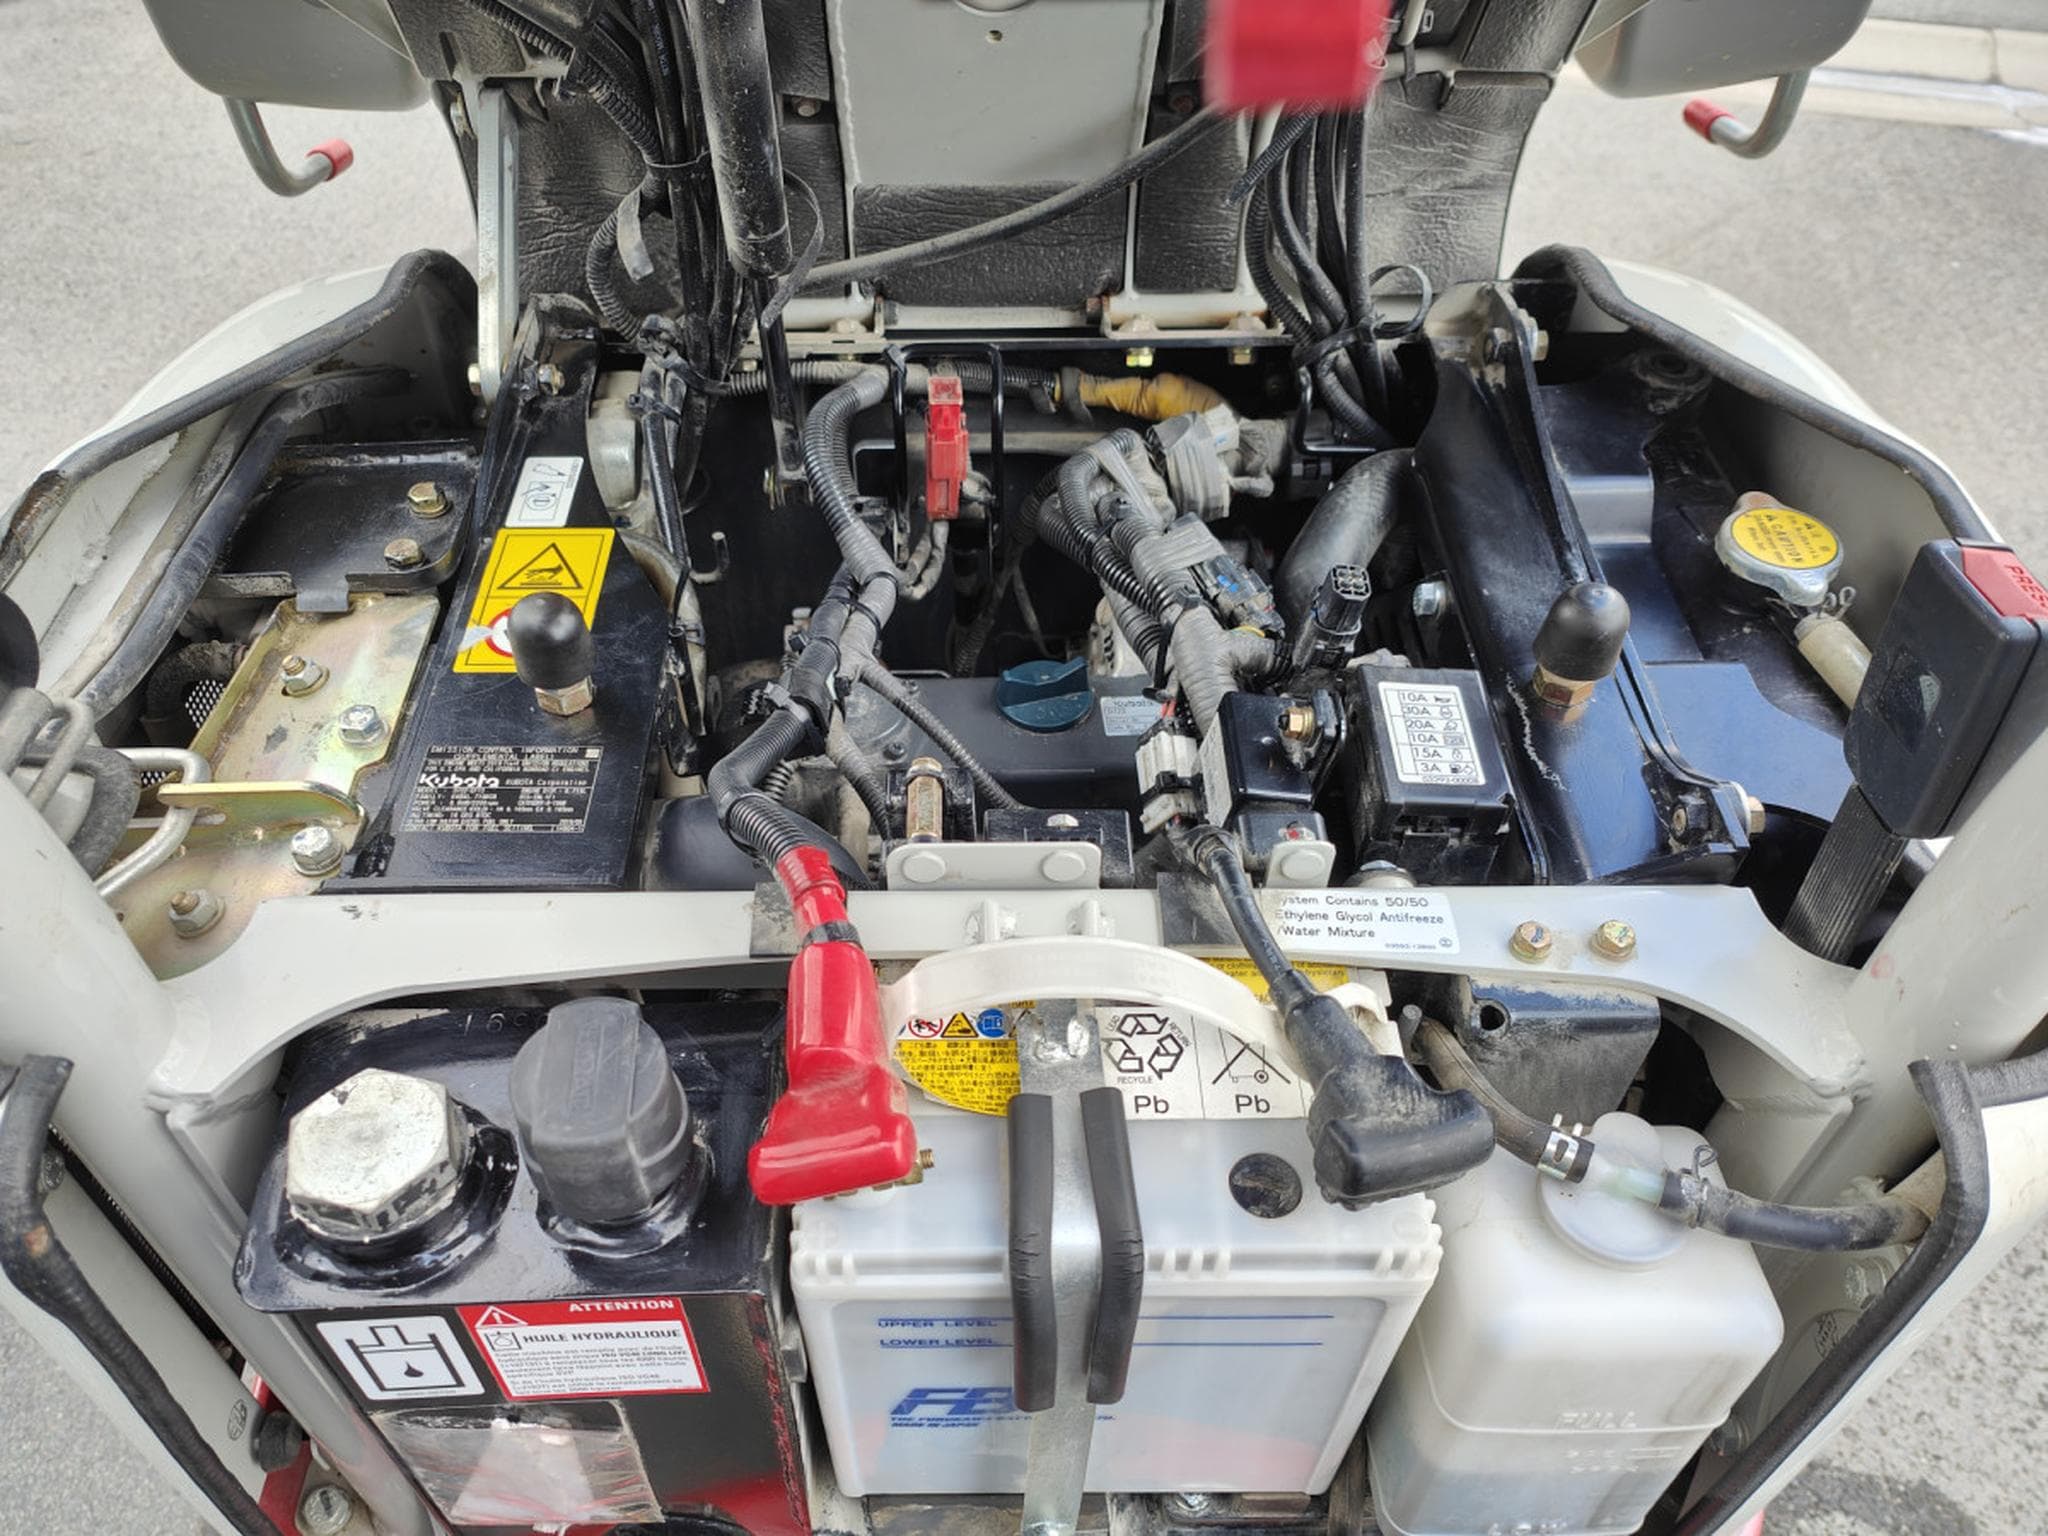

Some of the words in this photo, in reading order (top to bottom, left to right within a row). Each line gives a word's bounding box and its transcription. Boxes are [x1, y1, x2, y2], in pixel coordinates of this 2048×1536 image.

[2004, 563, 2048, 609] PRES
[1401, 692, 1428, 702] 10A
[1407, 719, 1435, 730] 20A
[1411, 733, 1439, 744] 10A
[1414, 747, 1443, 759] 15A
[1421, 762, 1442, 773] 3A
[419, 773, 500, 788] Kubota
[1281, 895, 1319, 907] ystem
[1325, 895, 1379, 907] Contains
[1385, 896, 1429, 908] 50/50
[1275, 910, 1329, 922] Ethylene
[1335, 911, 1373, 923] Glycol
[1379, 912, 1444, 925] Antifreeze
[1327, 925, 1375, 939] Mixture
[1117, 1076, 1154, 1085] RECYCLE
[1134, 1095, 1170, 1114] Pb
[1235, 1094, 1271, 1114] Pb
[569, 1300, 674, 1313] ATTENTION
[878, 1319, 934, 1328] UPPER
[944, 1319, 998, 1328] LEVEL
[523, 1331, 569, 1344] HUILE
[572, 1329, 682, 1342] HYDRAULIQUE
[880, 1339, 940, 1347] LOWER
[945, 1339, 994, 1347] LEVEL
